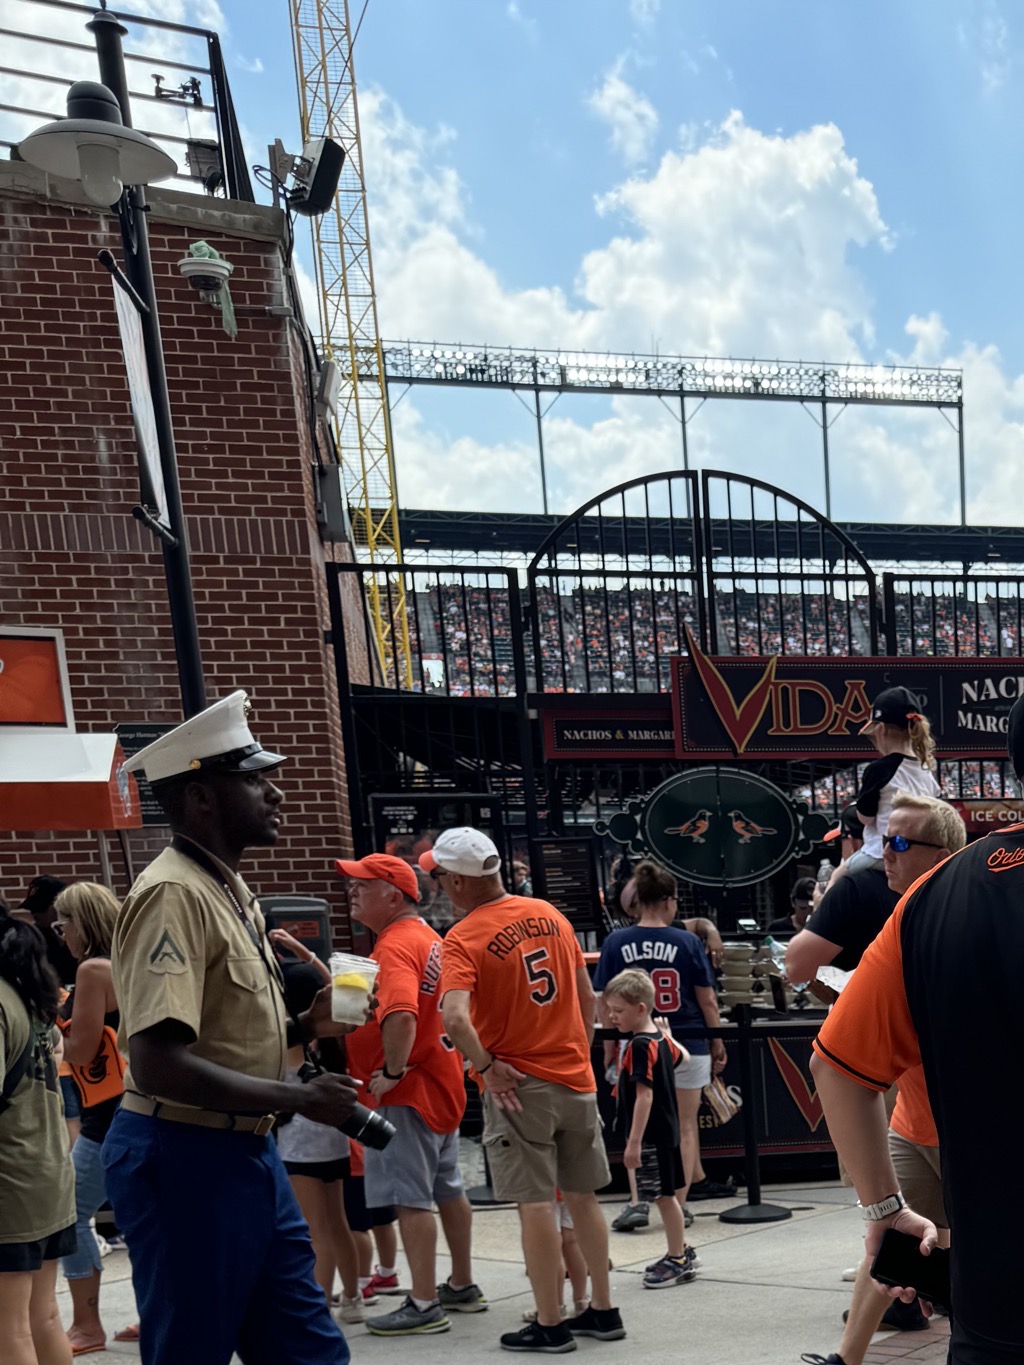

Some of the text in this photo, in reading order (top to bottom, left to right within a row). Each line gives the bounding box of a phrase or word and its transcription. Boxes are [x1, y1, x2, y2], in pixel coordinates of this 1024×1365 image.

[683, 621, 873, 755] VIDA
[563, 730, 612, 740] NACHOS
[615, 729, 625, 739] &
[971, 811, 994, 822] ICE
[487, 917, 560, 960] ROBINSON
[621, 941, 678, 963] OLSON
[524, 947, 557, 1006] 5
[651, 967, 681, 1013] 8
